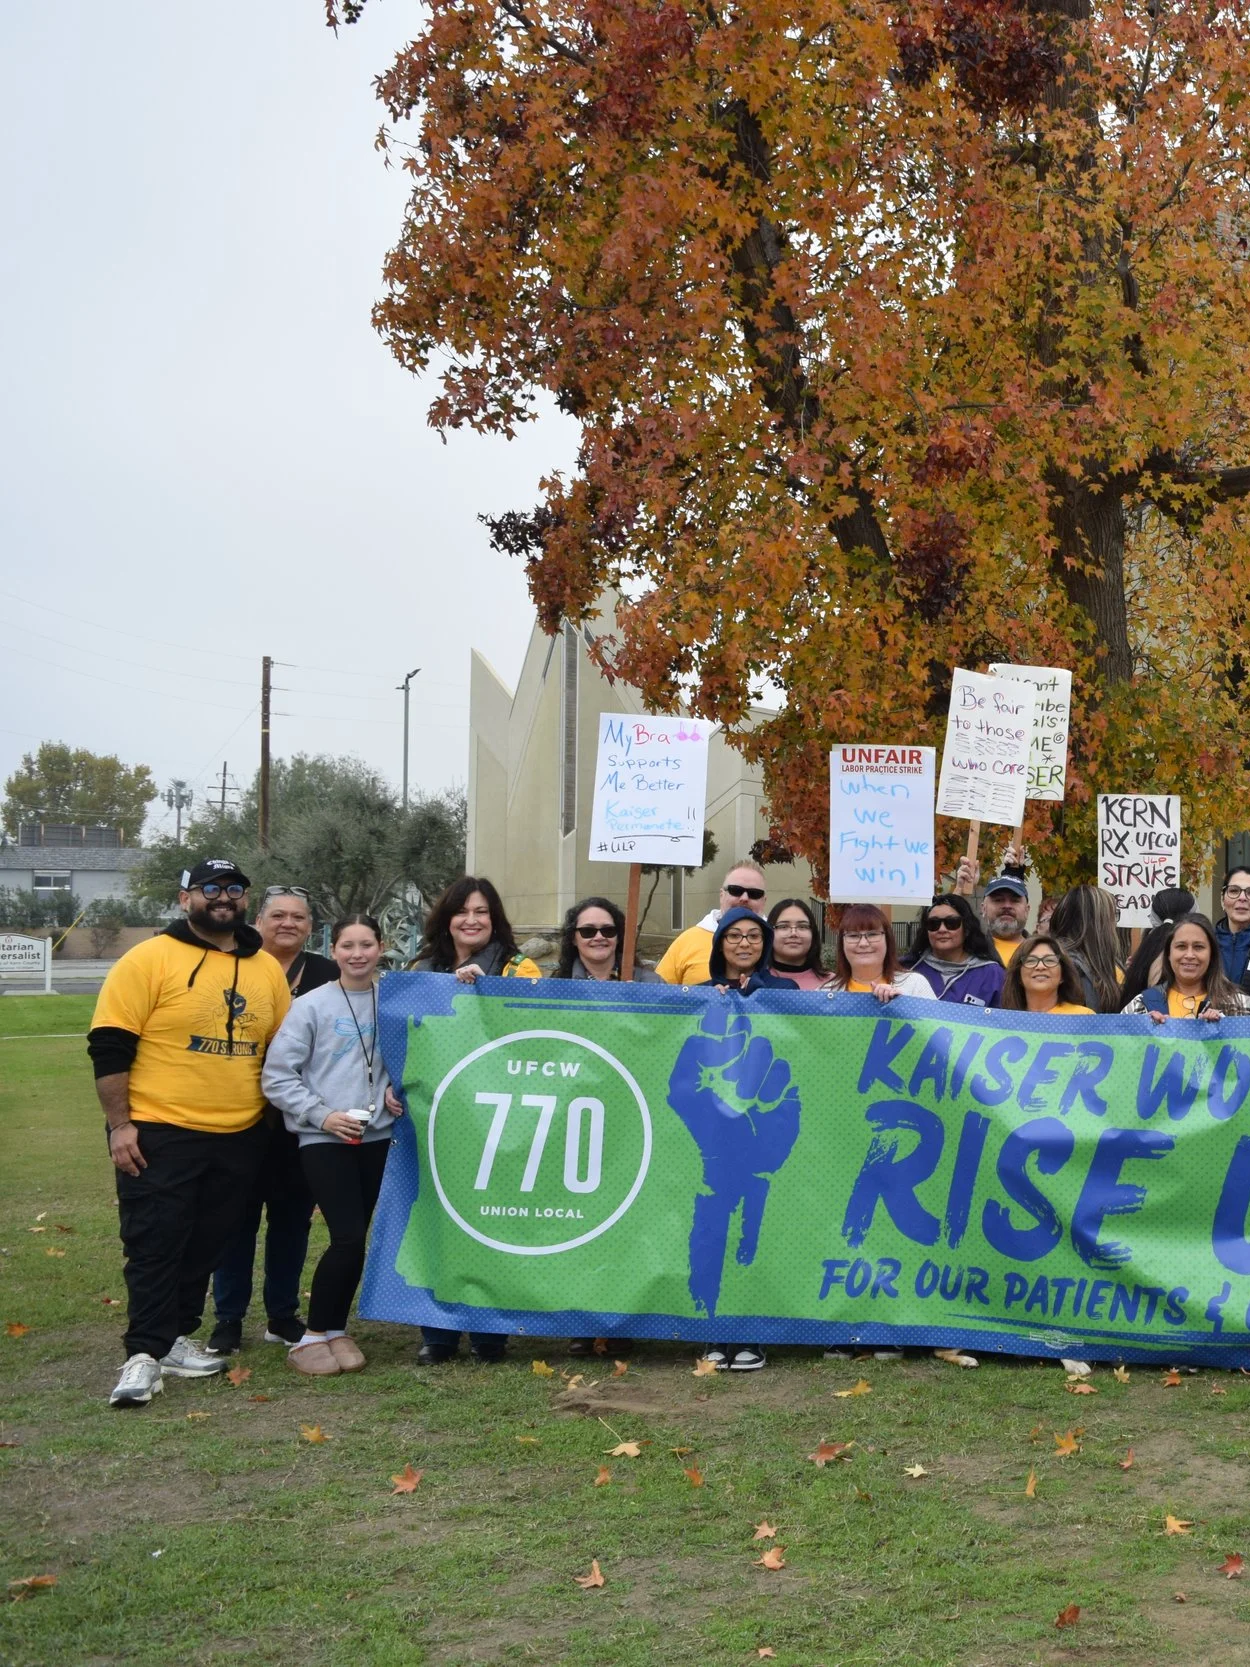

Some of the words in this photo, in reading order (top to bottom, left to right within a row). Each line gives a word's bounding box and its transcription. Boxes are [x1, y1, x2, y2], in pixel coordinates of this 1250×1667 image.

[956, 685, 986, 711] Be
[992, 692, 1026, 715] fair
[604, 719, 632, 756] My
[632, 724, 671, 745] Bra
[950, 715, 971, 730] to
[975, 719, 1025, 741] those
[842, 748, 922, 764] UNFAIR
[601, 771, 626, 792] Me
[632, 774, 686, 791] Better
[841, 765, 863, 773] LABOR
[865, 765, 897, 774] PRACTICE
[899, 766, 922, 774] STRIKE
[1027, 765, 1064, 786] SER
[1101, 795, 1171, 828] KERN
[1101, 828, 1130, 858] RX
[1143, 856, 1167, 866] ULP
[1103, 862, 1177, 888] STRIKE
[1114, 894, 1155, 909] EAD
[198, 1039, 219, 1053] 770
[220, 1041, 252, 1055] SRONG
[507, 1060, 580, 1077] UFCW
[857, 1019, 1114, 1117] KAISER
[474, 1092, 605, 1193] 770
[841, 1100, 1177, 1271] RISE
[480, 1206, 528, 1217] UNION
[535, 1207, 584, 1219] LOCAL
[818, 1257, 902, 1300] FOR
[914, 1259, 990, 1305] OUR
[1003, 1271, 1190, 1325] PATIENTS
[1204, 1281, 1232, 1337] &
